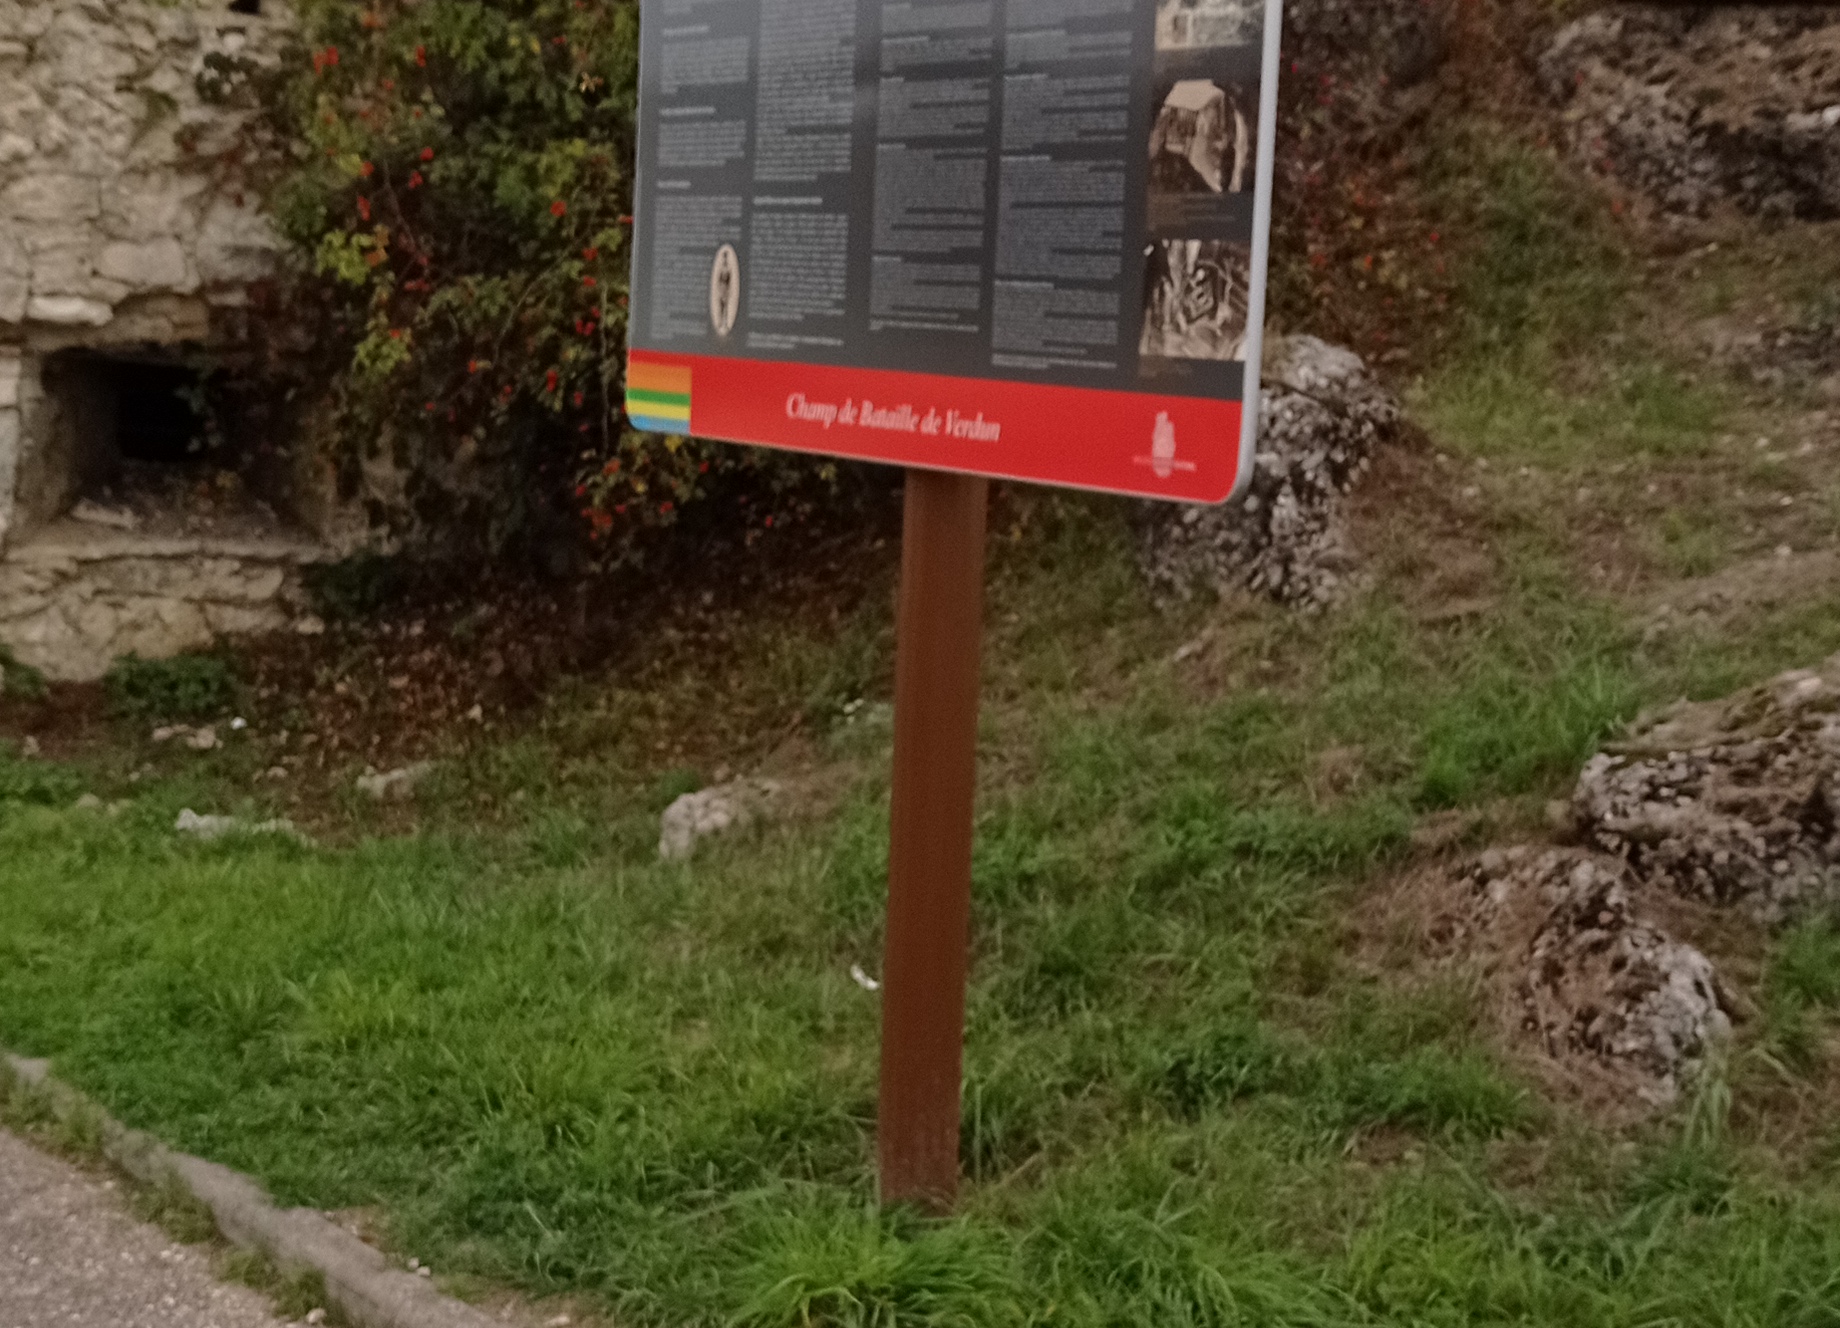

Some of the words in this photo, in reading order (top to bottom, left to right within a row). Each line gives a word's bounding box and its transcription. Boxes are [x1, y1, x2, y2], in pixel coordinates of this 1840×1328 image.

[785, 392, 838, 429] Champ
[837, 397, 859, 425] de
[858, 400, 920, 433] Bataille
[919, 407, 943, 435] de
[944, 409, 1002, 443] Verdun
